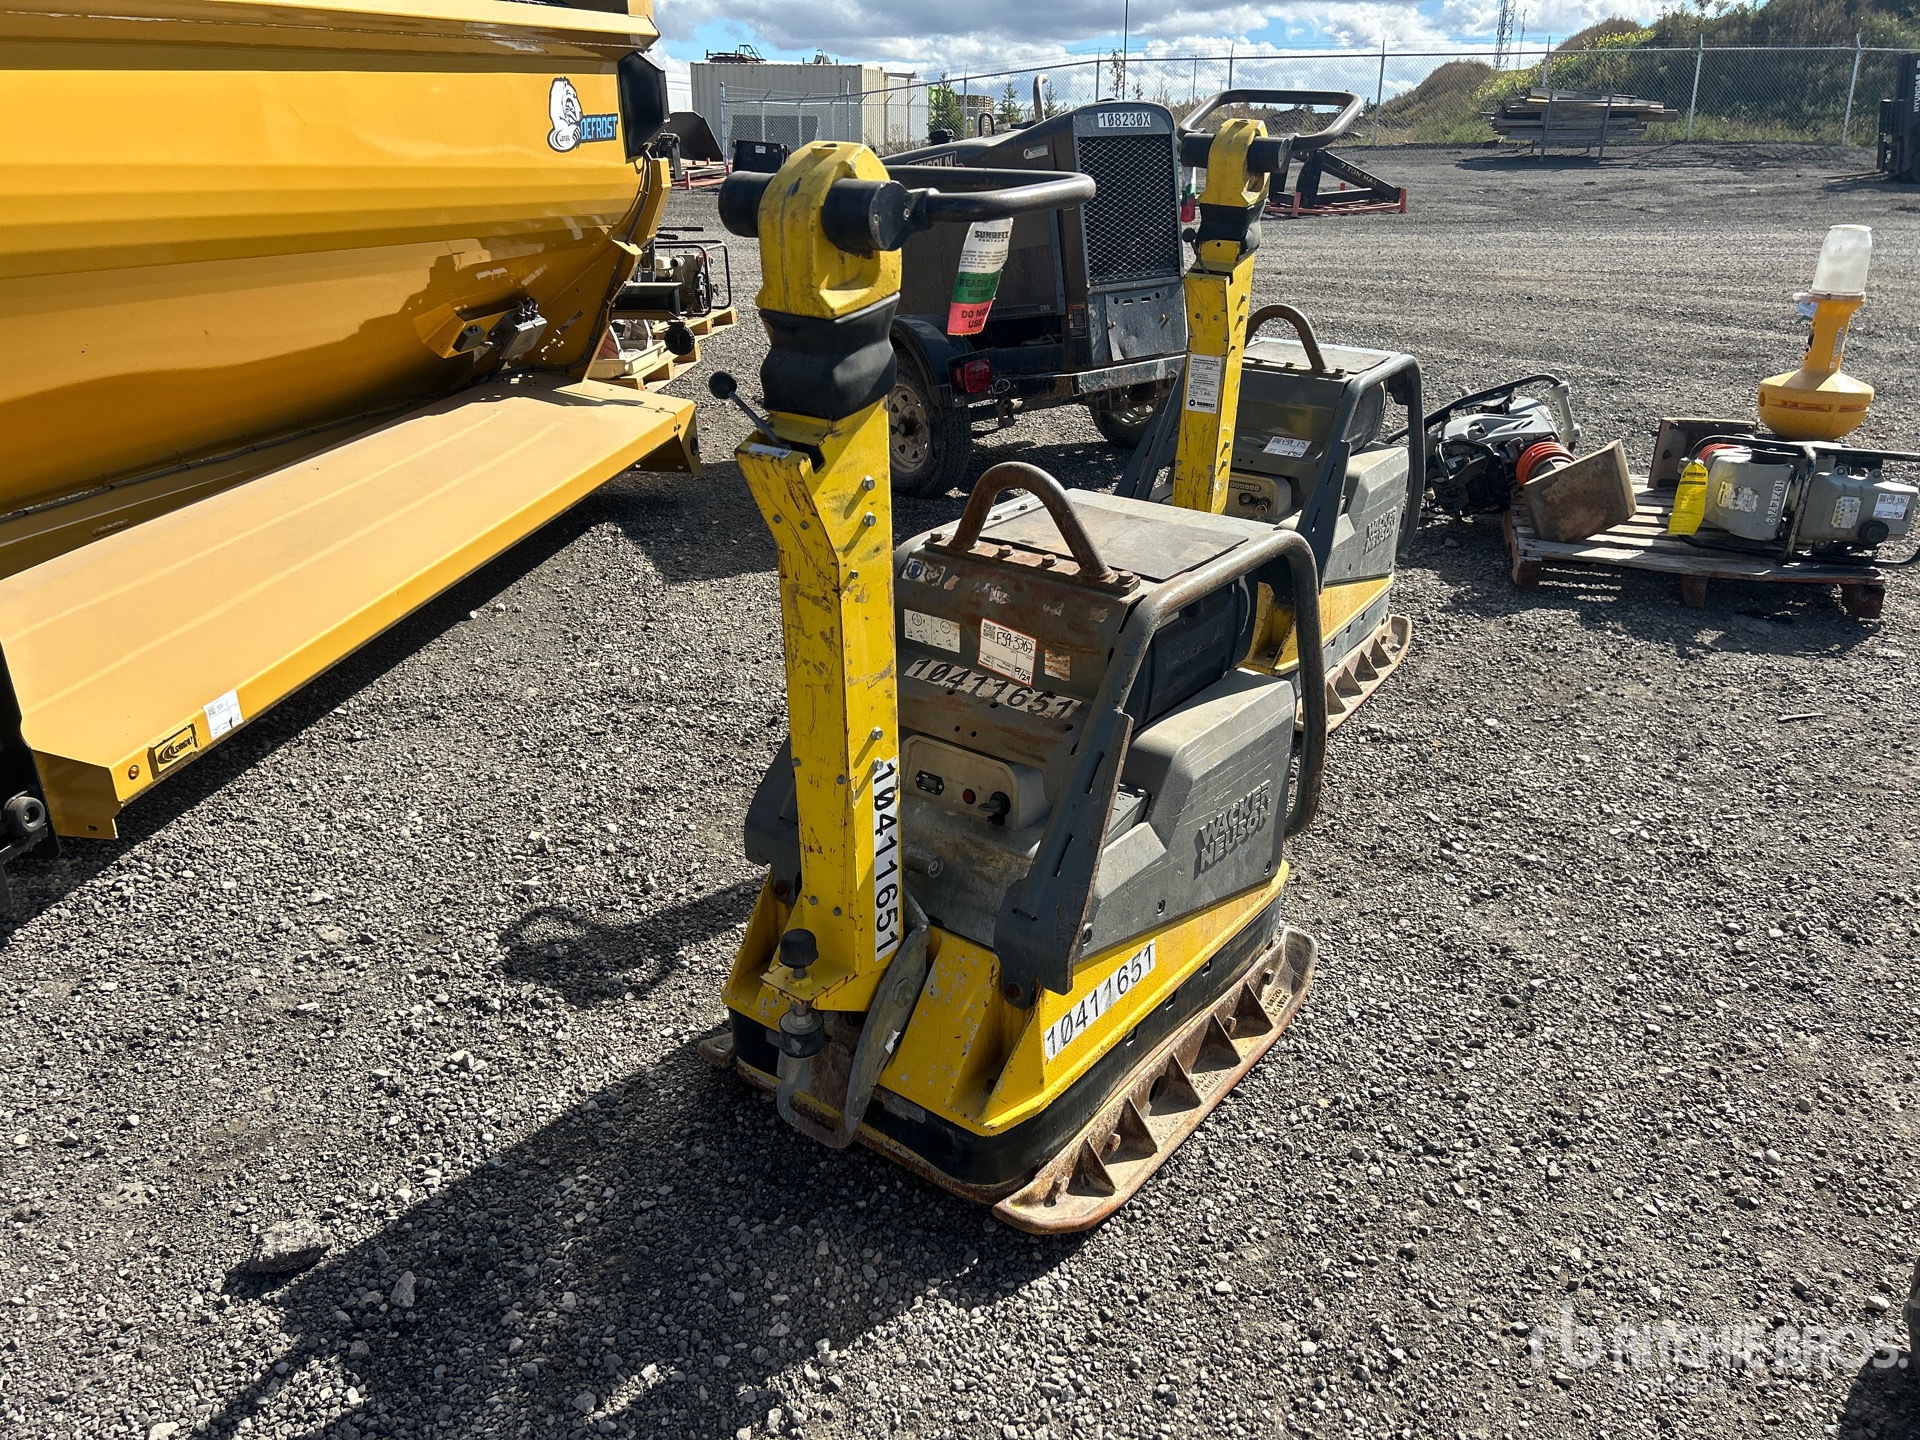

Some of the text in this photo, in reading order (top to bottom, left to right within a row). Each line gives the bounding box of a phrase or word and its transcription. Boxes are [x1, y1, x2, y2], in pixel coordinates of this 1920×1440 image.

[580, 116, 617, 140] DEFROST
[1100, 113, 1150, 126] 108230X
[1347, 166, 1361, 178] TON
[961, 310, 974, 318] DO
[968, 319, 982, 328] USE
[1014, 666, 1031, 685] 9/29
[912, 659, 1074, 719] 10411651
[874, 763, 898, 953] 10411651
[1047, 942, 1154, 1056] 10411651
